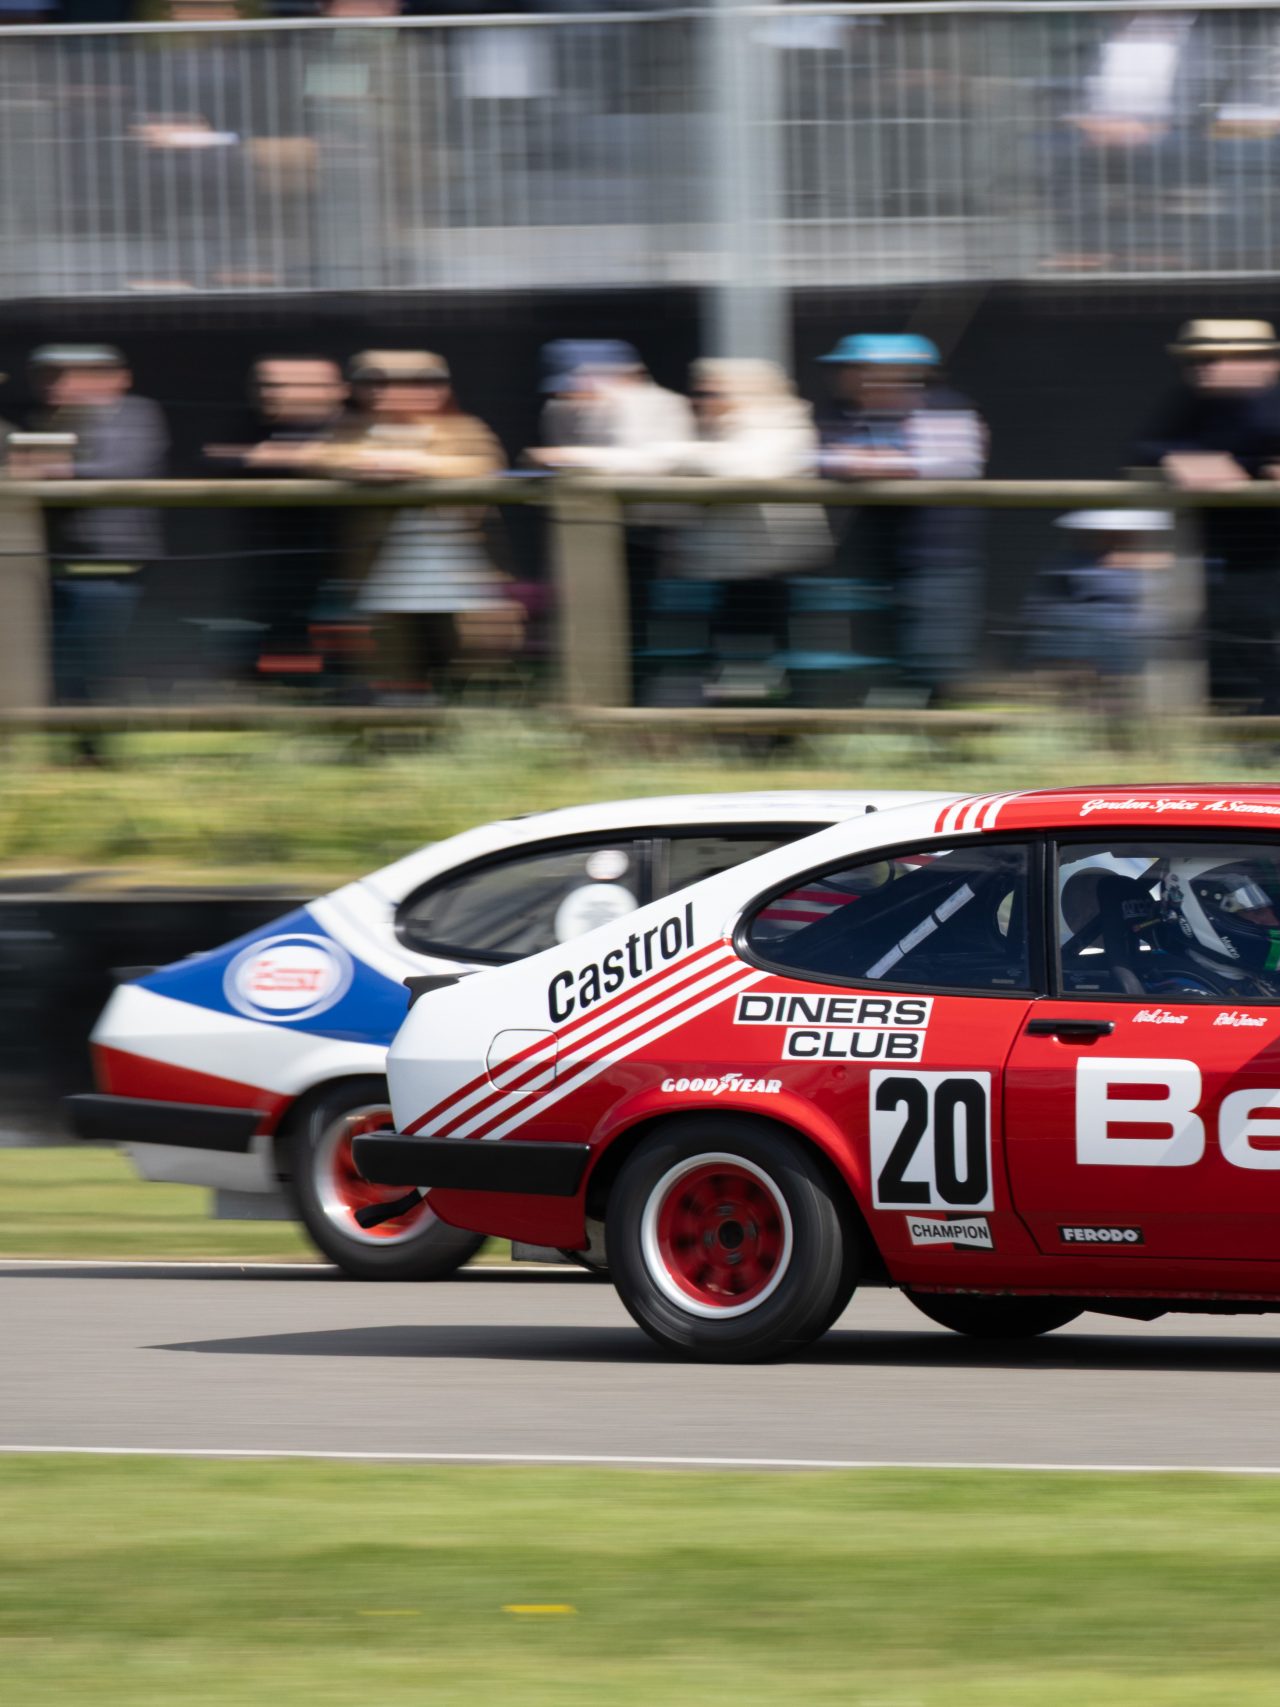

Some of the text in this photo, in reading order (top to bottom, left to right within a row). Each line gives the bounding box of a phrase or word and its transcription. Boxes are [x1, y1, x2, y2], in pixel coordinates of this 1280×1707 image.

[1079, 799, 1150, 816] Gordon
[1148, 799, 1199, 813] Spice
[548, 901, 694, 1024] Castrol
[738, 995, 926, 1025] DINERS
[788, 1030, 919, 1059] CLUB
[875, 1077, 989, 1205] 20
[911, 1223, 990, 1240] CHAMPION
[1063, 1228, 1138, 1242] FERODO
